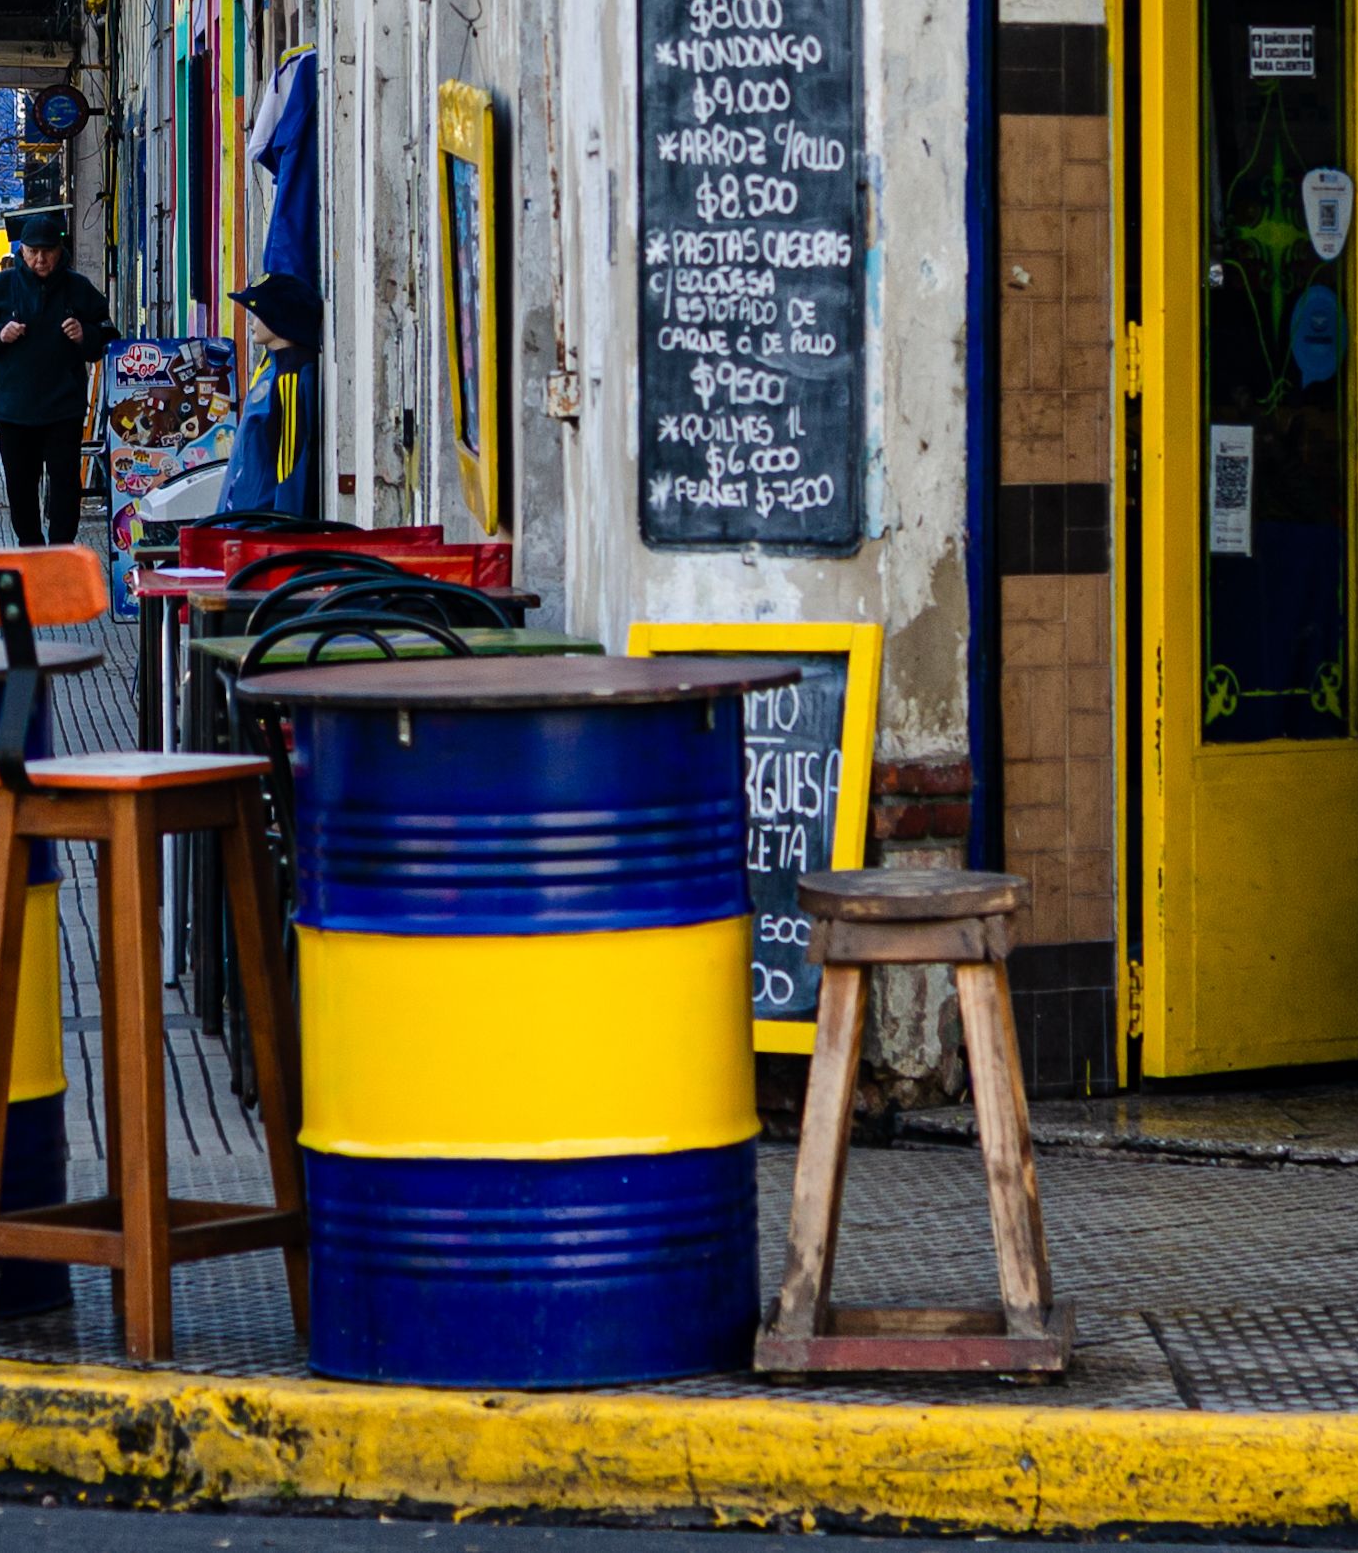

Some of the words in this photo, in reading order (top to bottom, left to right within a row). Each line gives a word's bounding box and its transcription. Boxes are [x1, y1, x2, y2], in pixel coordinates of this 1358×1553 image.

[679, 32, 822, 73] MONDONGO
[680, 123, 767, 167] ARROZ
[672, 228, 759, 265] PASTAS
[762, 229, 852, 268] CASERAS
[675, 295, 777, 326] ESTOFADO
[787, 298, 816, 329] DE
[658, 326, 732, 356] CARNE
[761, 332, 784, 356] DE
[790, 330, 836, 357] POLLO
[744, 684, 799, 732] MO
